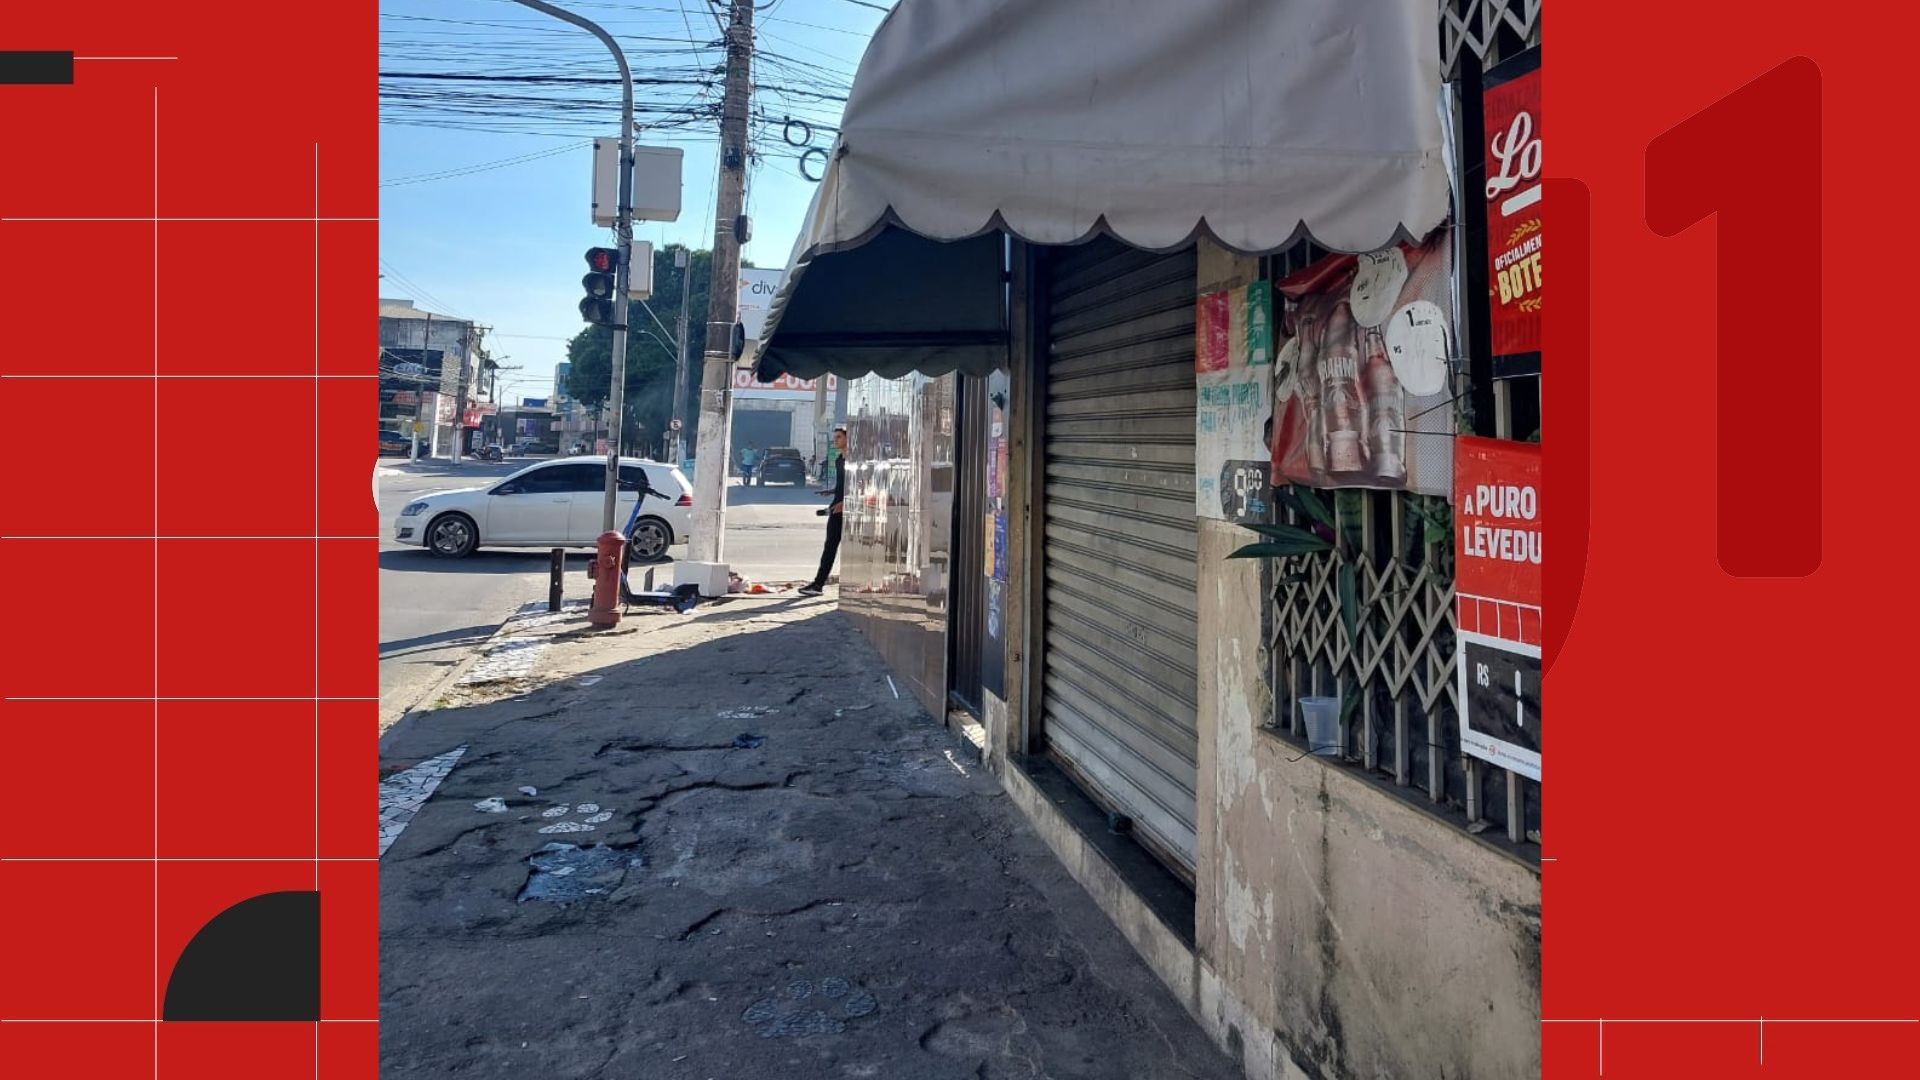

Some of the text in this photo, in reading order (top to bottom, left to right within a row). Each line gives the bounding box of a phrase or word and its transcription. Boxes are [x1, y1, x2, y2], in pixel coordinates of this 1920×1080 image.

[1464, 484, 1536, 520] A PURO
[1477, 662, 1490, 687] R$
